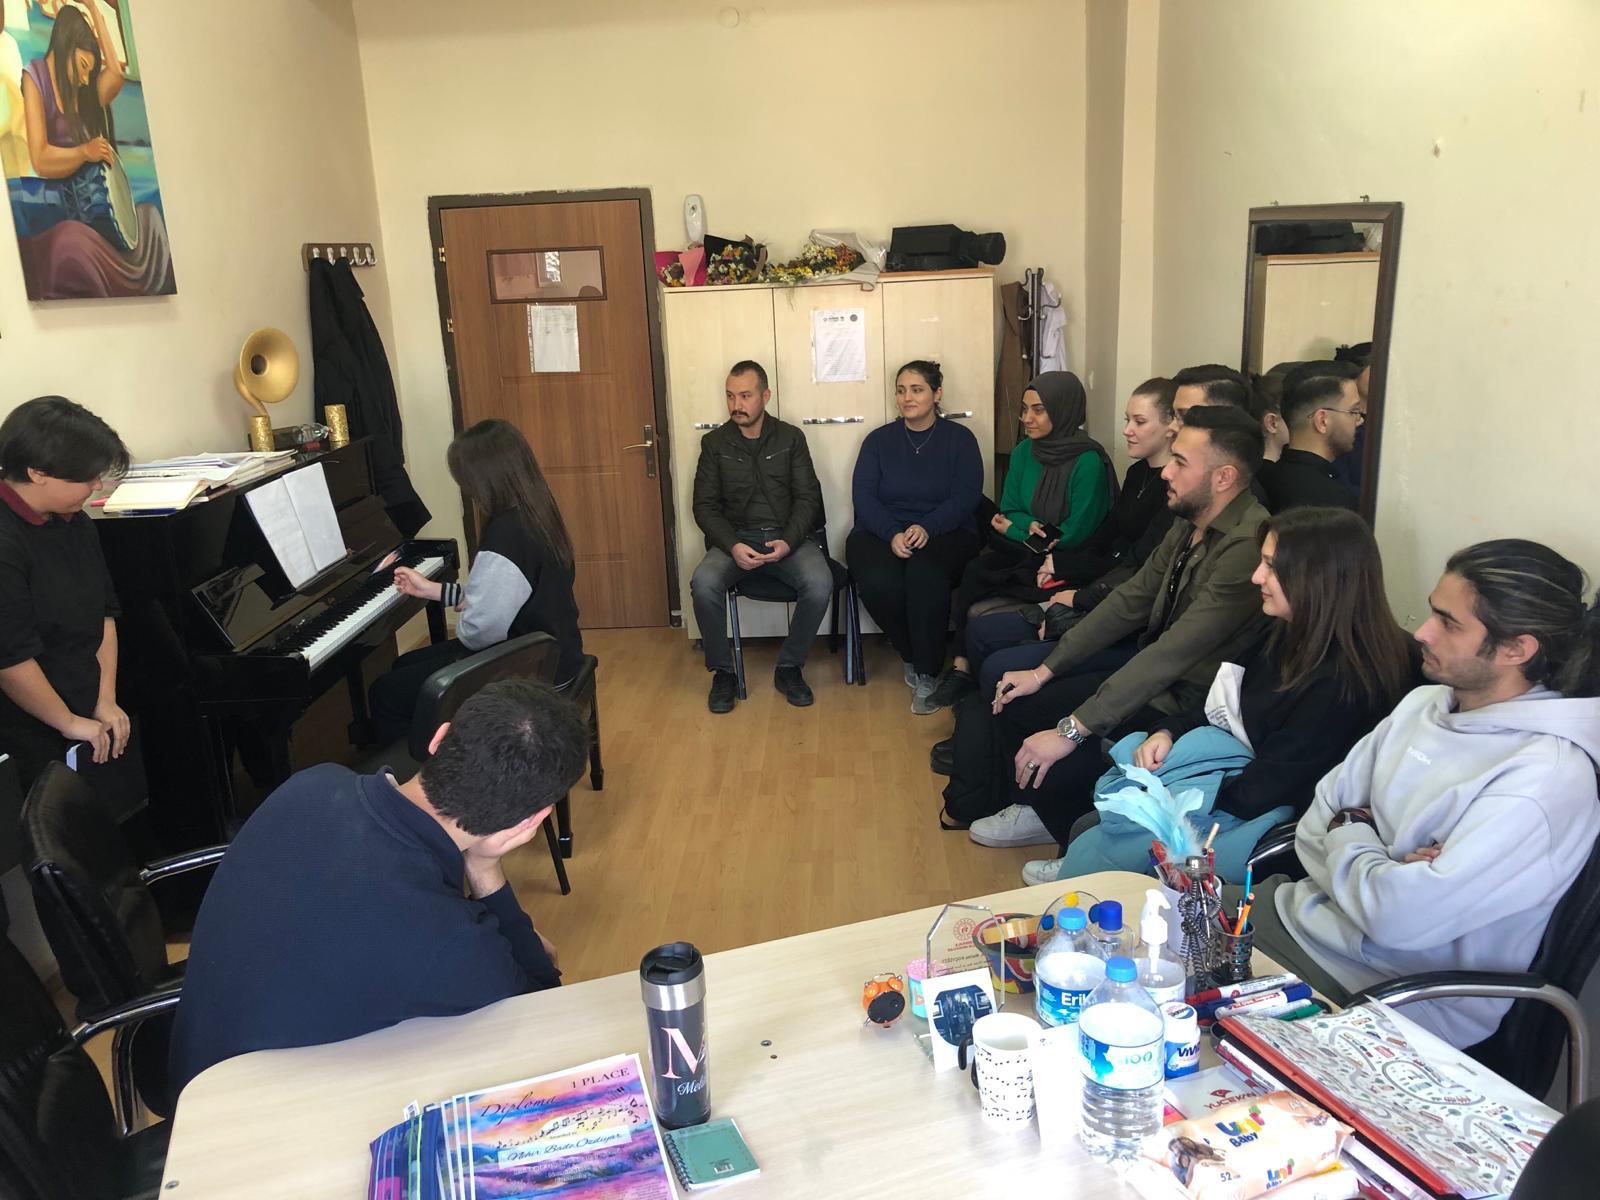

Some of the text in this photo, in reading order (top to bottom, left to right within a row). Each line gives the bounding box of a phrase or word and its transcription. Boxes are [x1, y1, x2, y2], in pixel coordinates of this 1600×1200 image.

[581, 1067, 630, 1087] PLACE
[480, 1090, 557, 1126] Diploma
[1220, 1171, 1233, 1183] 52
